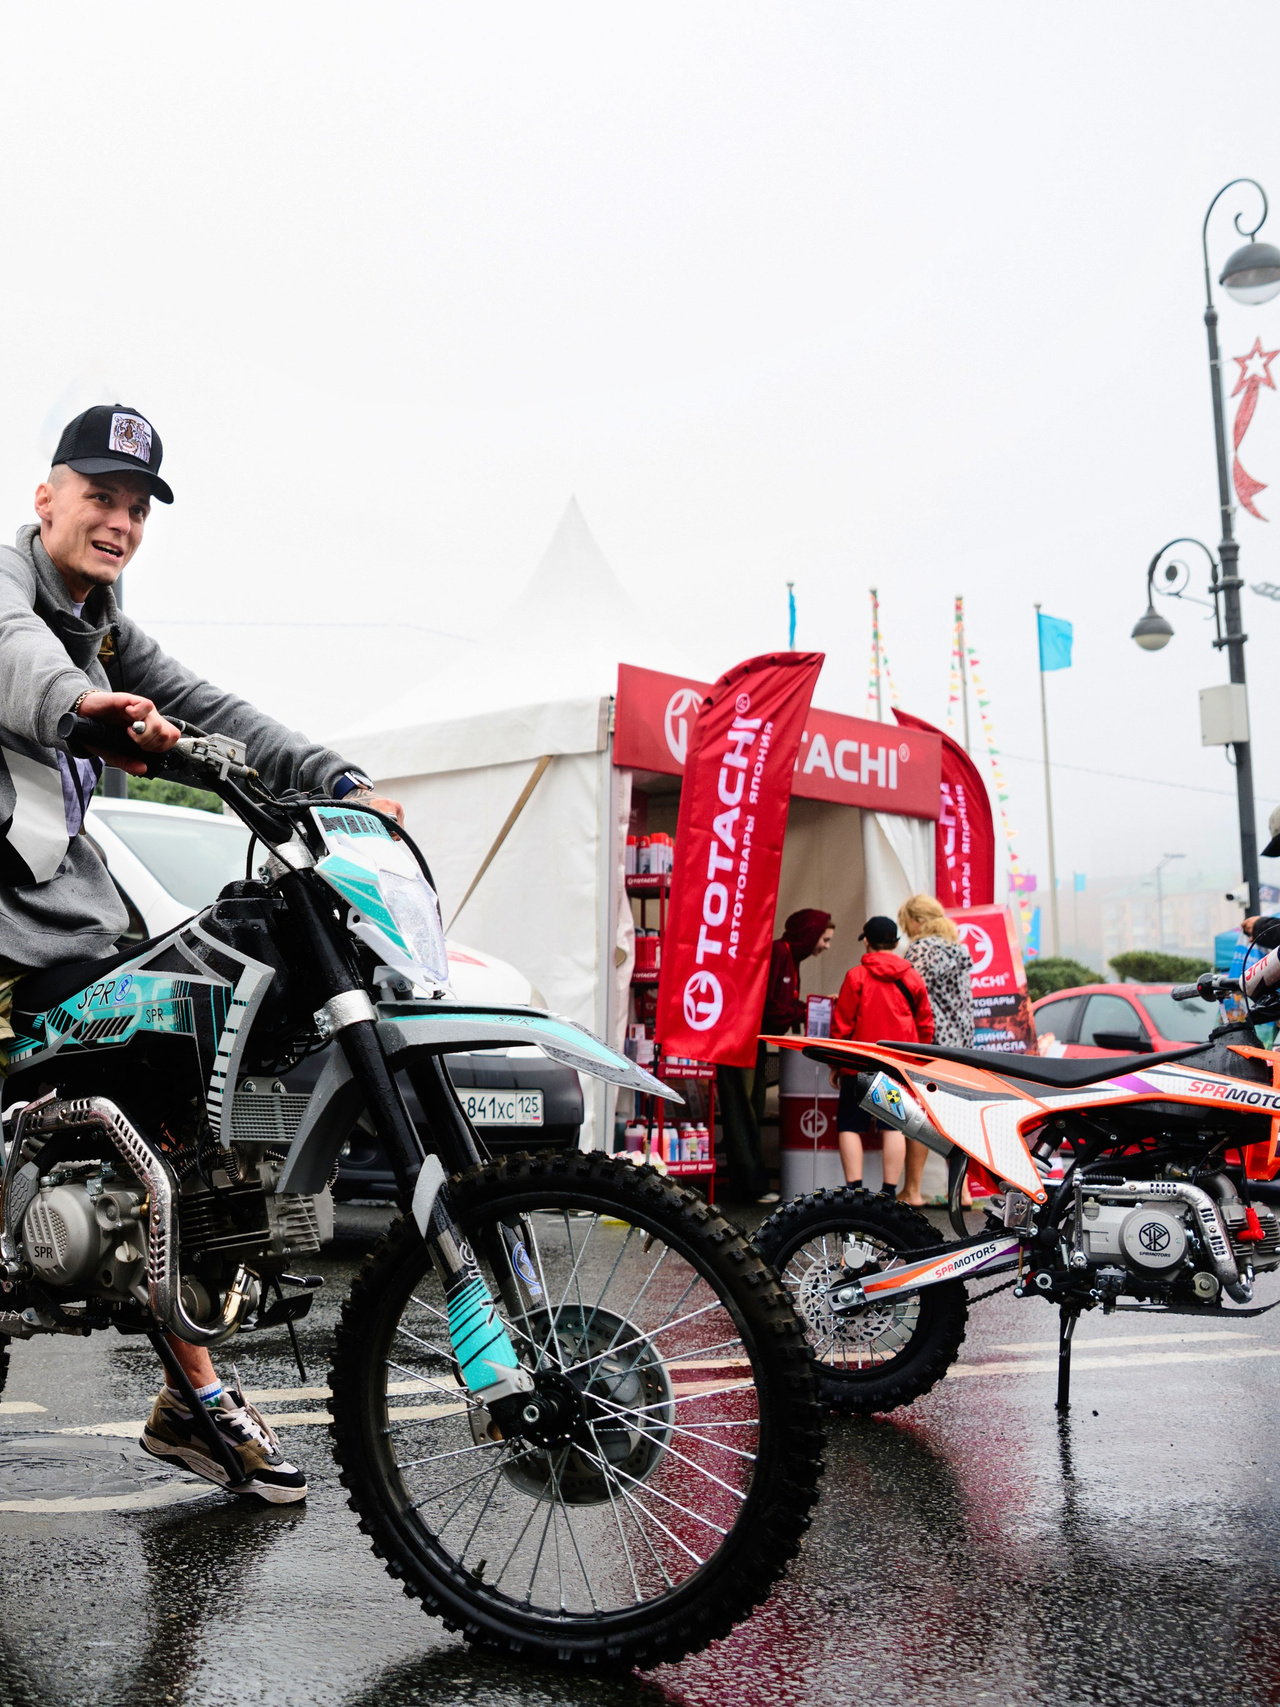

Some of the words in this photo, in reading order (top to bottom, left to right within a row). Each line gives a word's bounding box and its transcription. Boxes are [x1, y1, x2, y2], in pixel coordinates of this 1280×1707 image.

[955, 784, 971, 854] ЯПОНИЯ
[728, 815, 756, 960] АВТОТОВАРЫ
[748, 721, 774, 805] ЯПОНИЯ
[77, 980, 116, 1011] SPR
[145, 1008, 164, 1024] SPR
[493, 1016, 535, 1026] SPR
[517, 1096, 540, 1114] 125
[34, 1245, 54, 1260] SPR
[934, 1243, 997, 1279] SPRMOTORS
